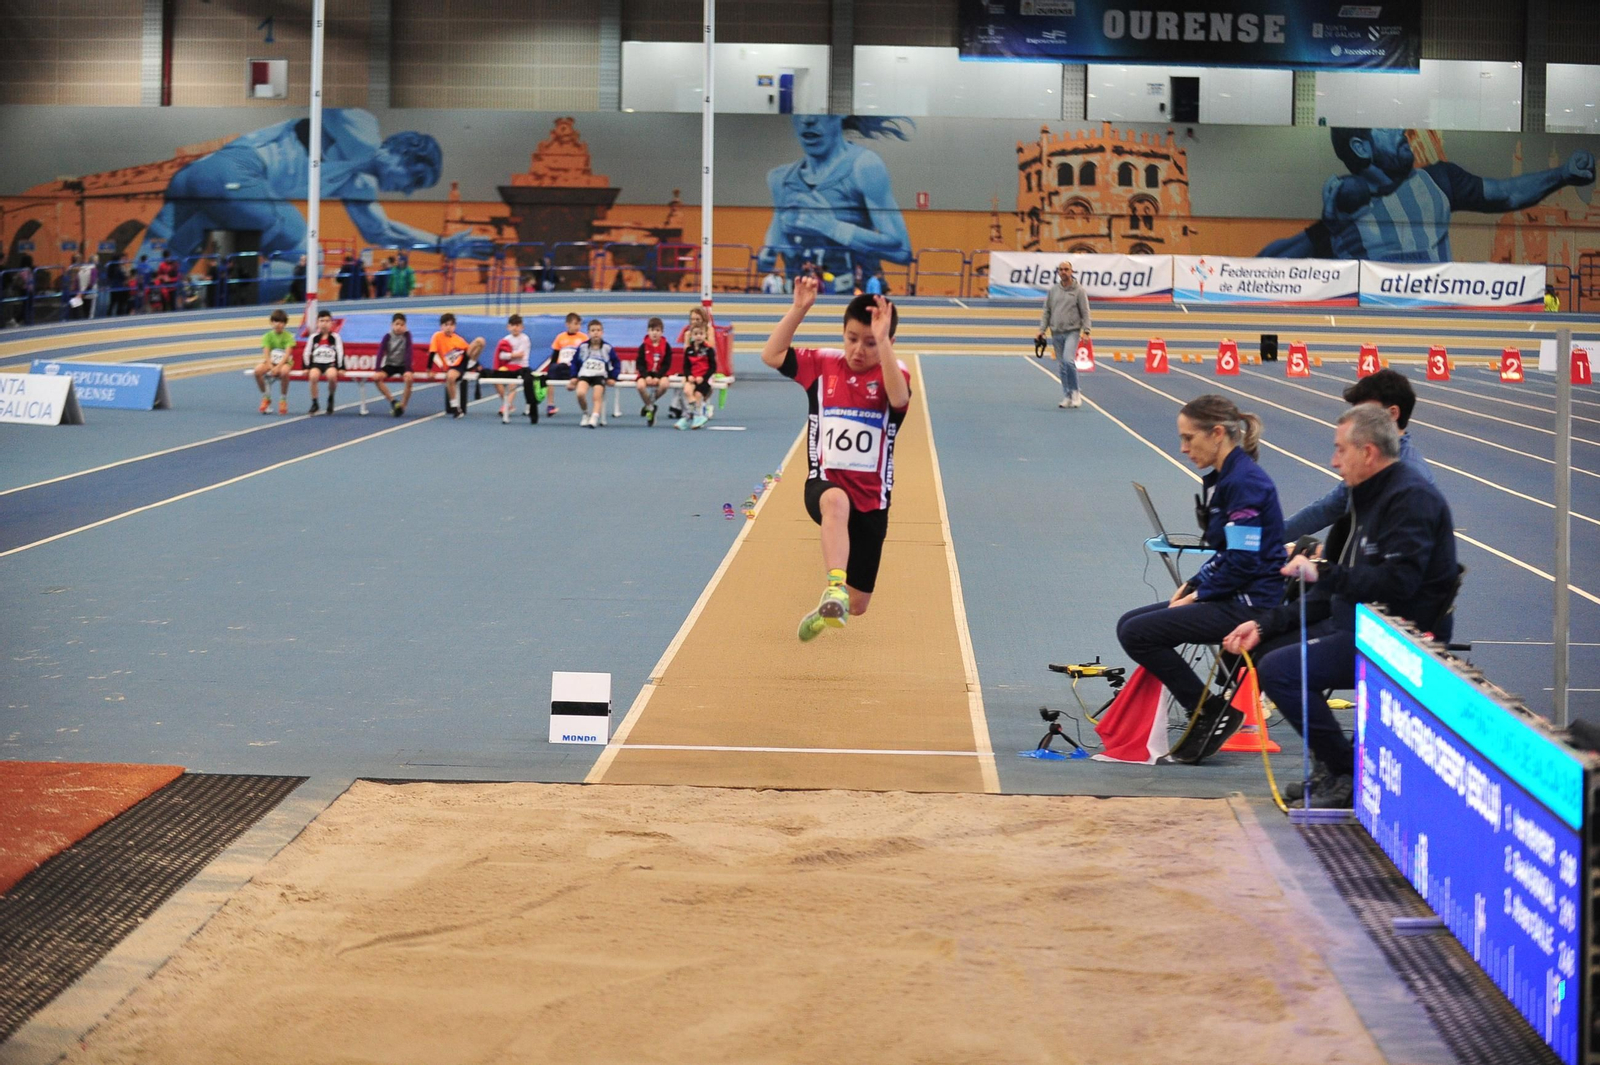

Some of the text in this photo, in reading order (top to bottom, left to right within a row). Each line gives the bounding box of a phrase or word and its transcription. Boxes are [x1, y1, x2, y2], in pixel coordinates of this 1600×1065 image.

[1103, 9, 1286, 44] OURENSE
[1219, 263, 1340, 284] Federación Galega
[1219, 280, 1302, 294] de Atletismo
[1380, 273, 1526, 300] atletismo.gal
[1076, 347, 1089, 364] 8
[1150, 349, 1163, 368] 7
[1221, 351, 1234, 370] 6
[1291, 353, 1304, 372] 5
[1361, 355, 1374, 373] 4
[1432, 355, 1445, 375] 3
[1504, 358, 1519, 378] 2
[1576, 361, 1584, 379] 1
[826, 428, 873, 453] 160
[562, 735, 597, 743] MONDO
